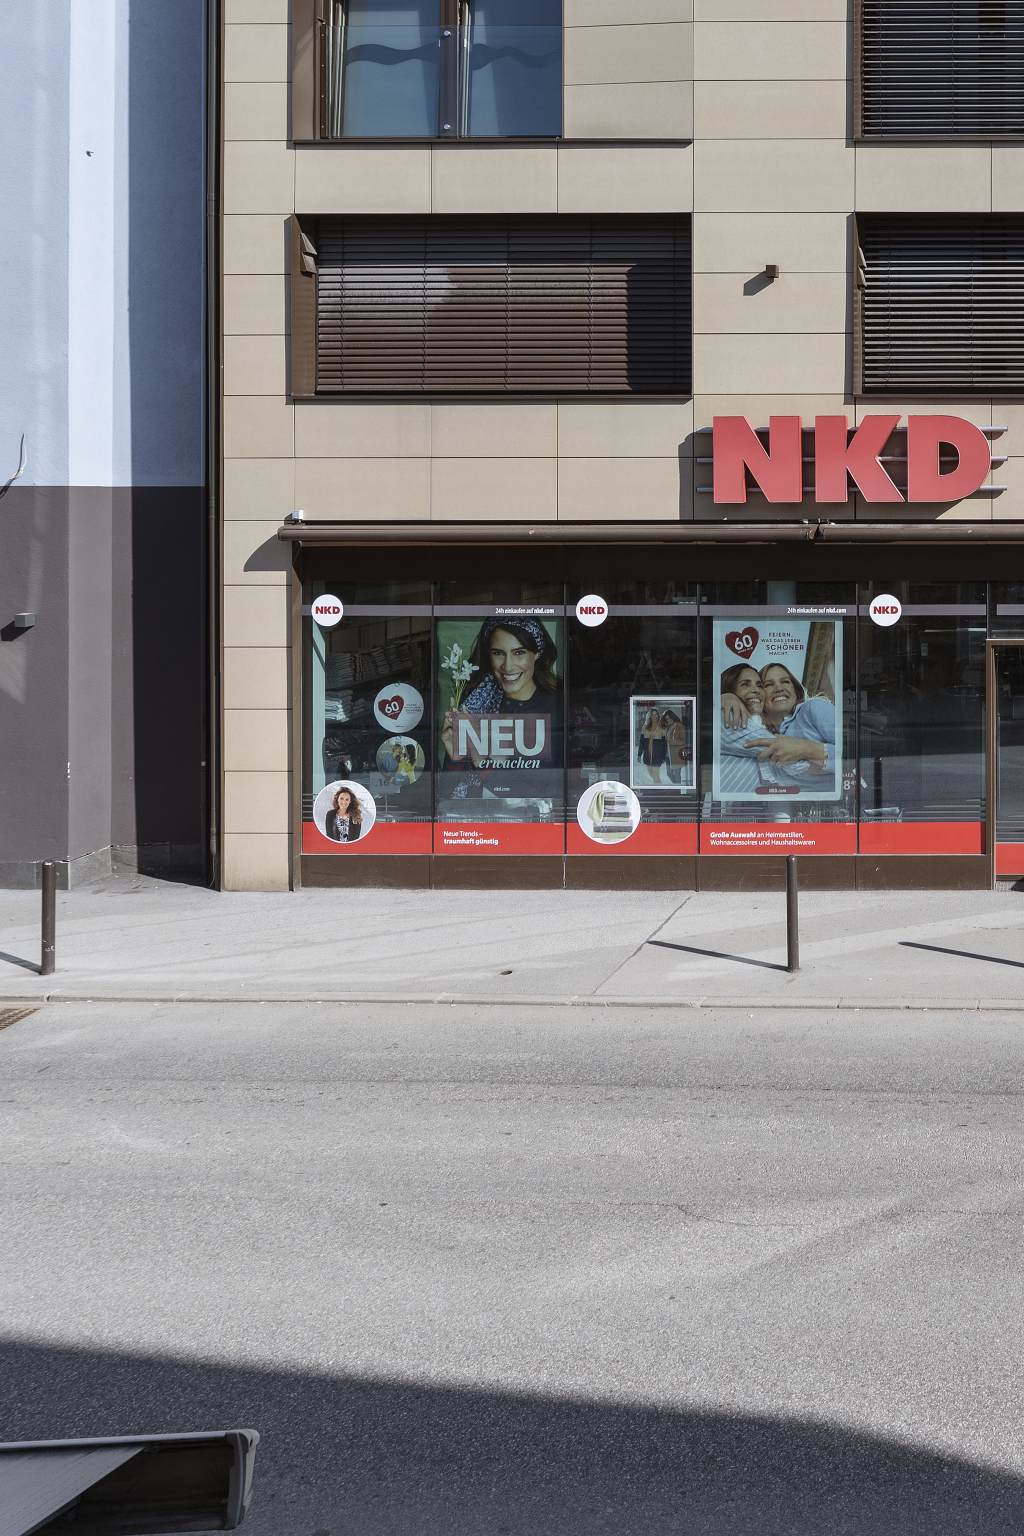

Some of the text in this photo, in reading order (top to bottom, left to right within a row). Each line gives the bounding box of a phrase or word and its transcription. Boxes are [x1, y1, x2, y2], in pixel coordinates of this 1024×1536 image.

[713, 415, 992, 503] NKD
[315, 606, 340, 615] NKD
[579, 606, 605, 615] NKD
[873, 606, 899, 615] NKD
[734, 634, 753, 651] 60
[766, 643, 804, 651] SCHÖNER
[385, 701, 400, 714] 60
[458, 719, 546, 757] NEU
[479, 757, 541, 769] erwachen
[475, 838, 499, 846] günstig
